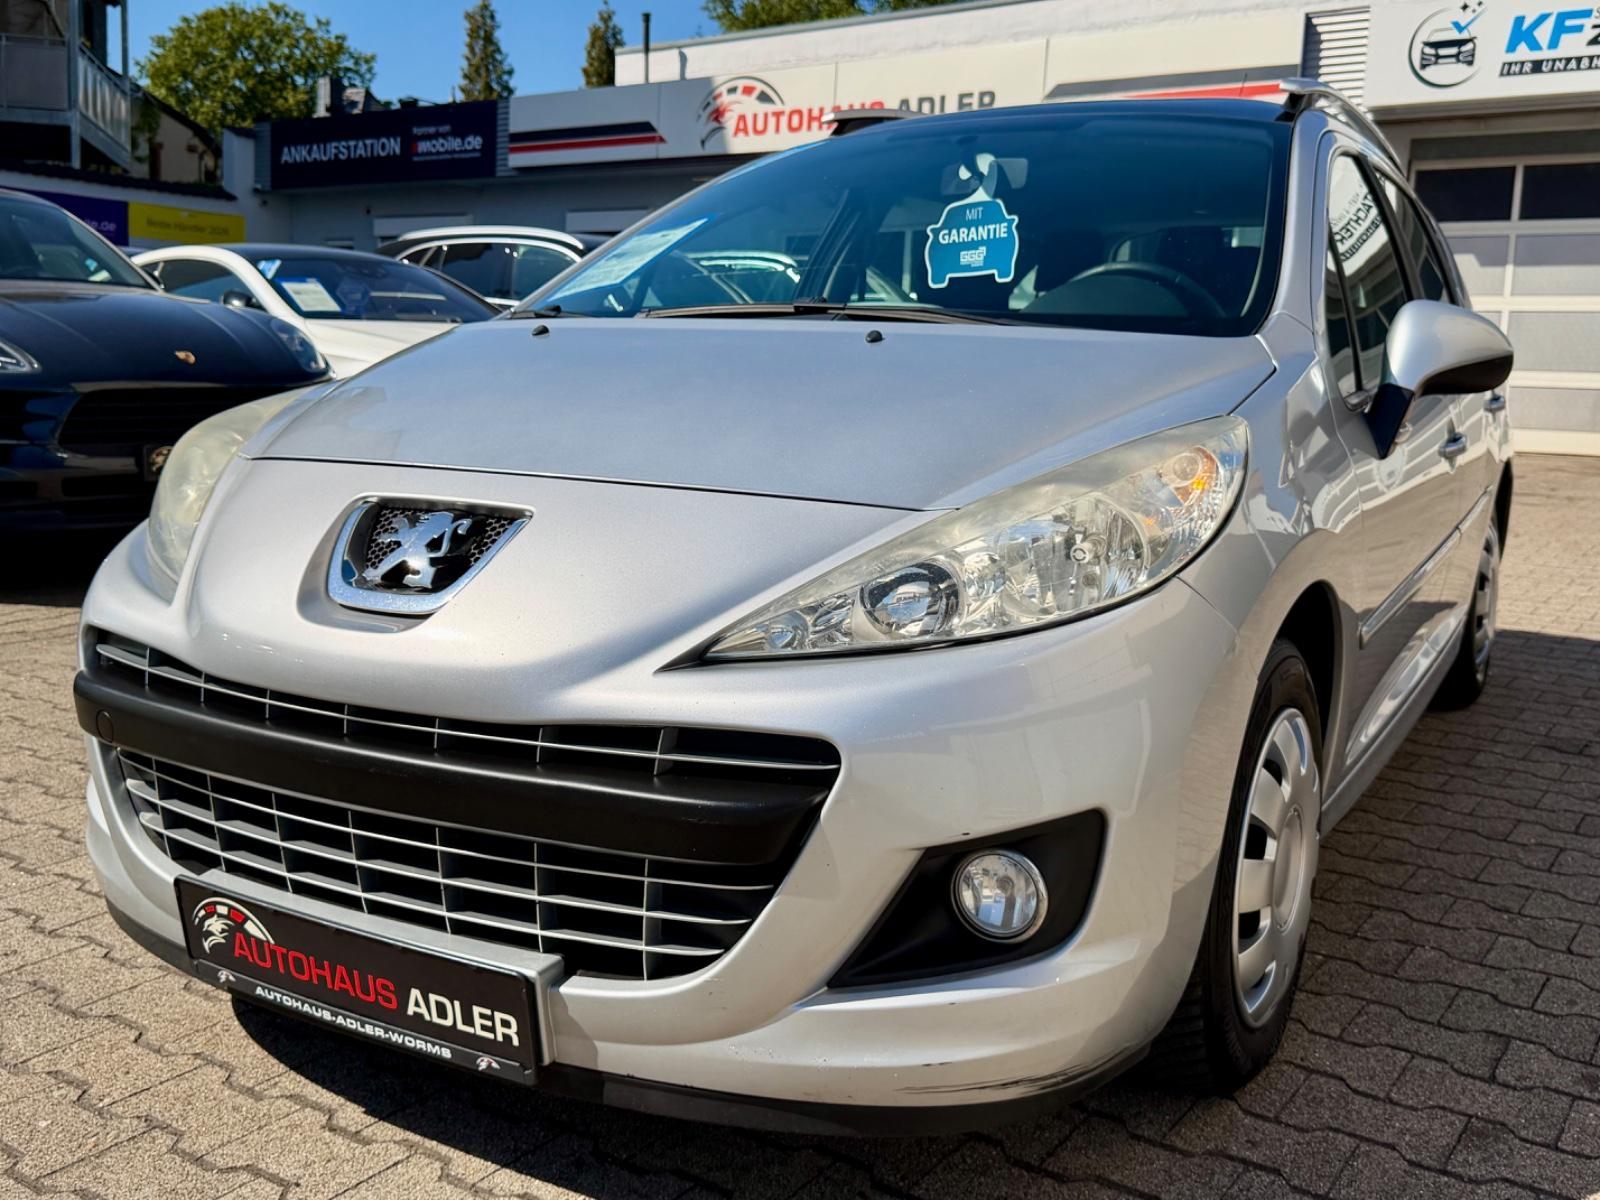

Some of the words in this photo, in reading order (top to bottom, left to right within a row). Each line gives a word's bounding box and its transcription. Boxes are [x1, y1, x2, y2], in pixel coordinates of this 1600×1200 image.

[1502, 61, 1533, 75] IHR
[281, 137, 401, 164] ANKAUFSTATION
[965, 207, 984, 221] MIT
[938, 222, 1009, 245] GARANTIE
[233, 932, 398, 1010] AUTOHAUS
[406, 987, 520, 1047] ADLER
